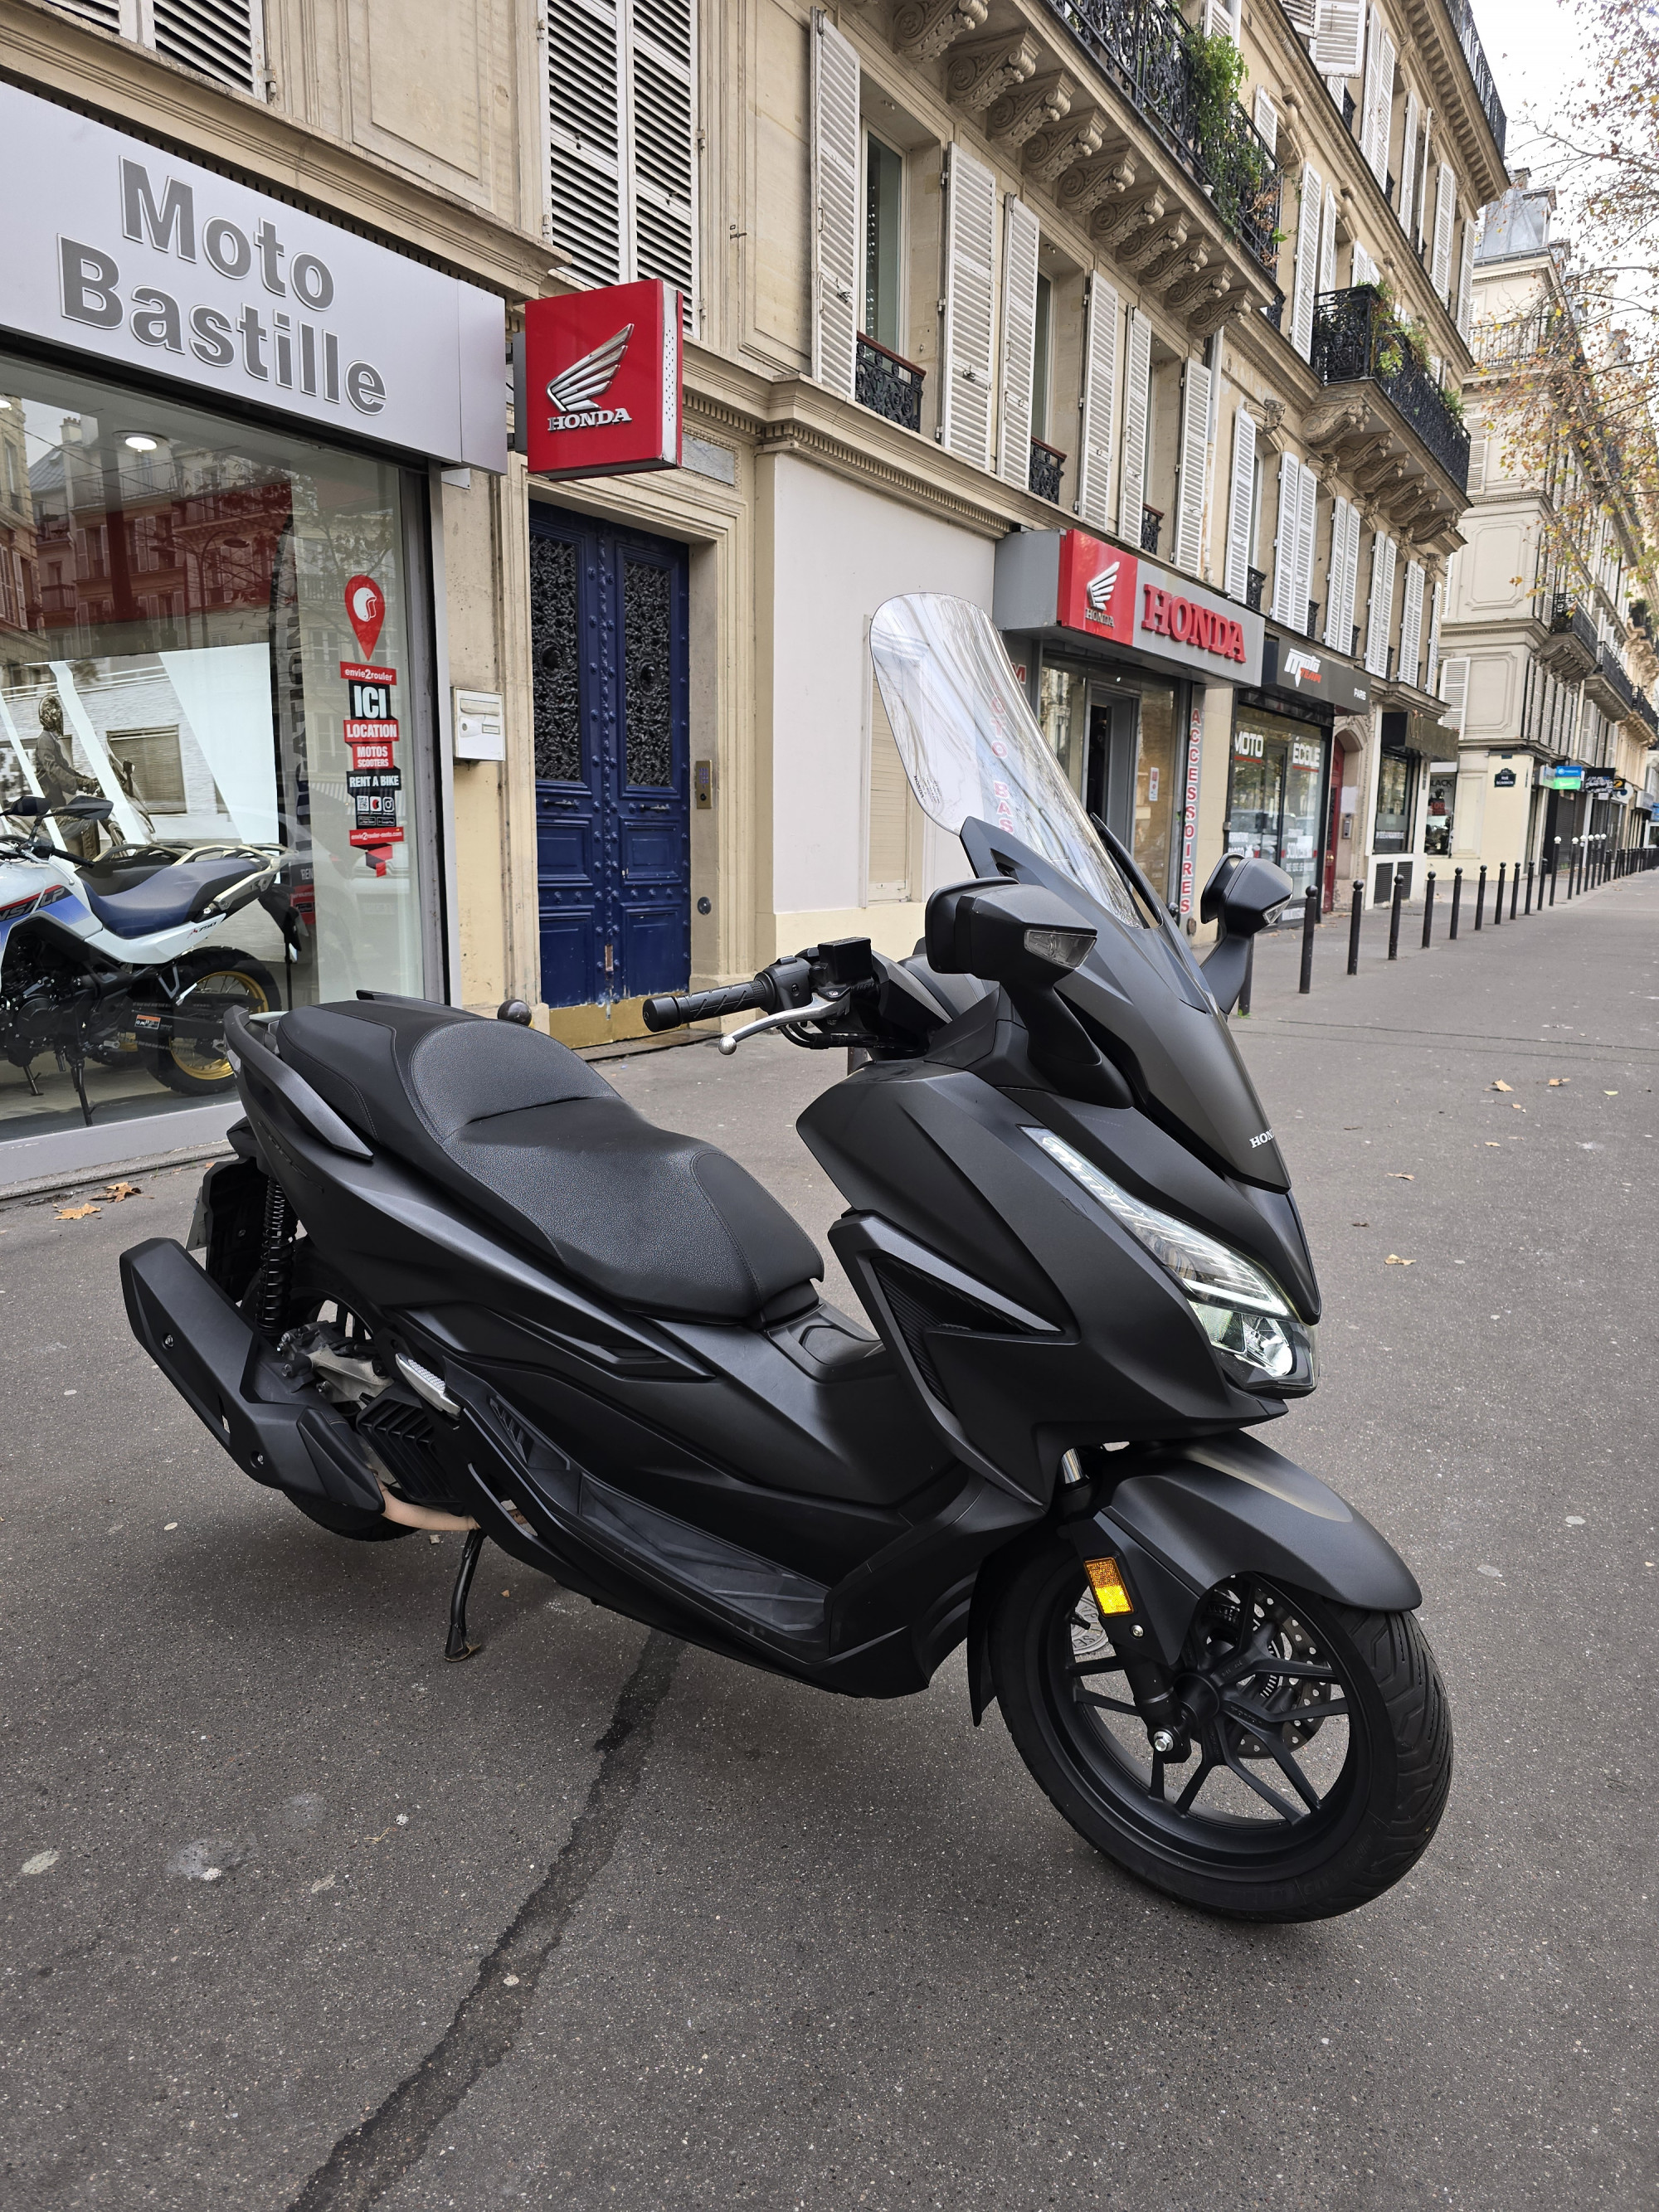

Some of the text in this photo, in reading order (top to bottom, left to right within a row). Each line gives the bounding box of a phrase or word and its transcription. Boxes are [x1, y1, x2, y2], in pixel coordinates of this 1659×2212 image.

[119, 155, 335, 311] Moto
[57, 233, 387, 416] Bastille
[547, 407, 633, 433] HONDA
[1085, 608, 1116, 628] HONDA
[1141, 583, 1247, 664] HONDA
[344, 668, 394, 682] envie2rouler
[1301, 667, 1322, 684] TEAM
[353, 685, 387, 719] ICI
[346, 723, 397, 738] LOCATION
[356, 746, 388, 757] MOTOS
[357, 758, 389, 768] SCOOTERS
[1292, 735, 1321, 768] ÉCOLE
[349, 775, 400, 788] RENT A BIKE
[913, 774, 925, 800] HONDA
[1430, 779, 1453, 788] LACK
[1180, 708, 1202, 914] ACCESSOIRES
